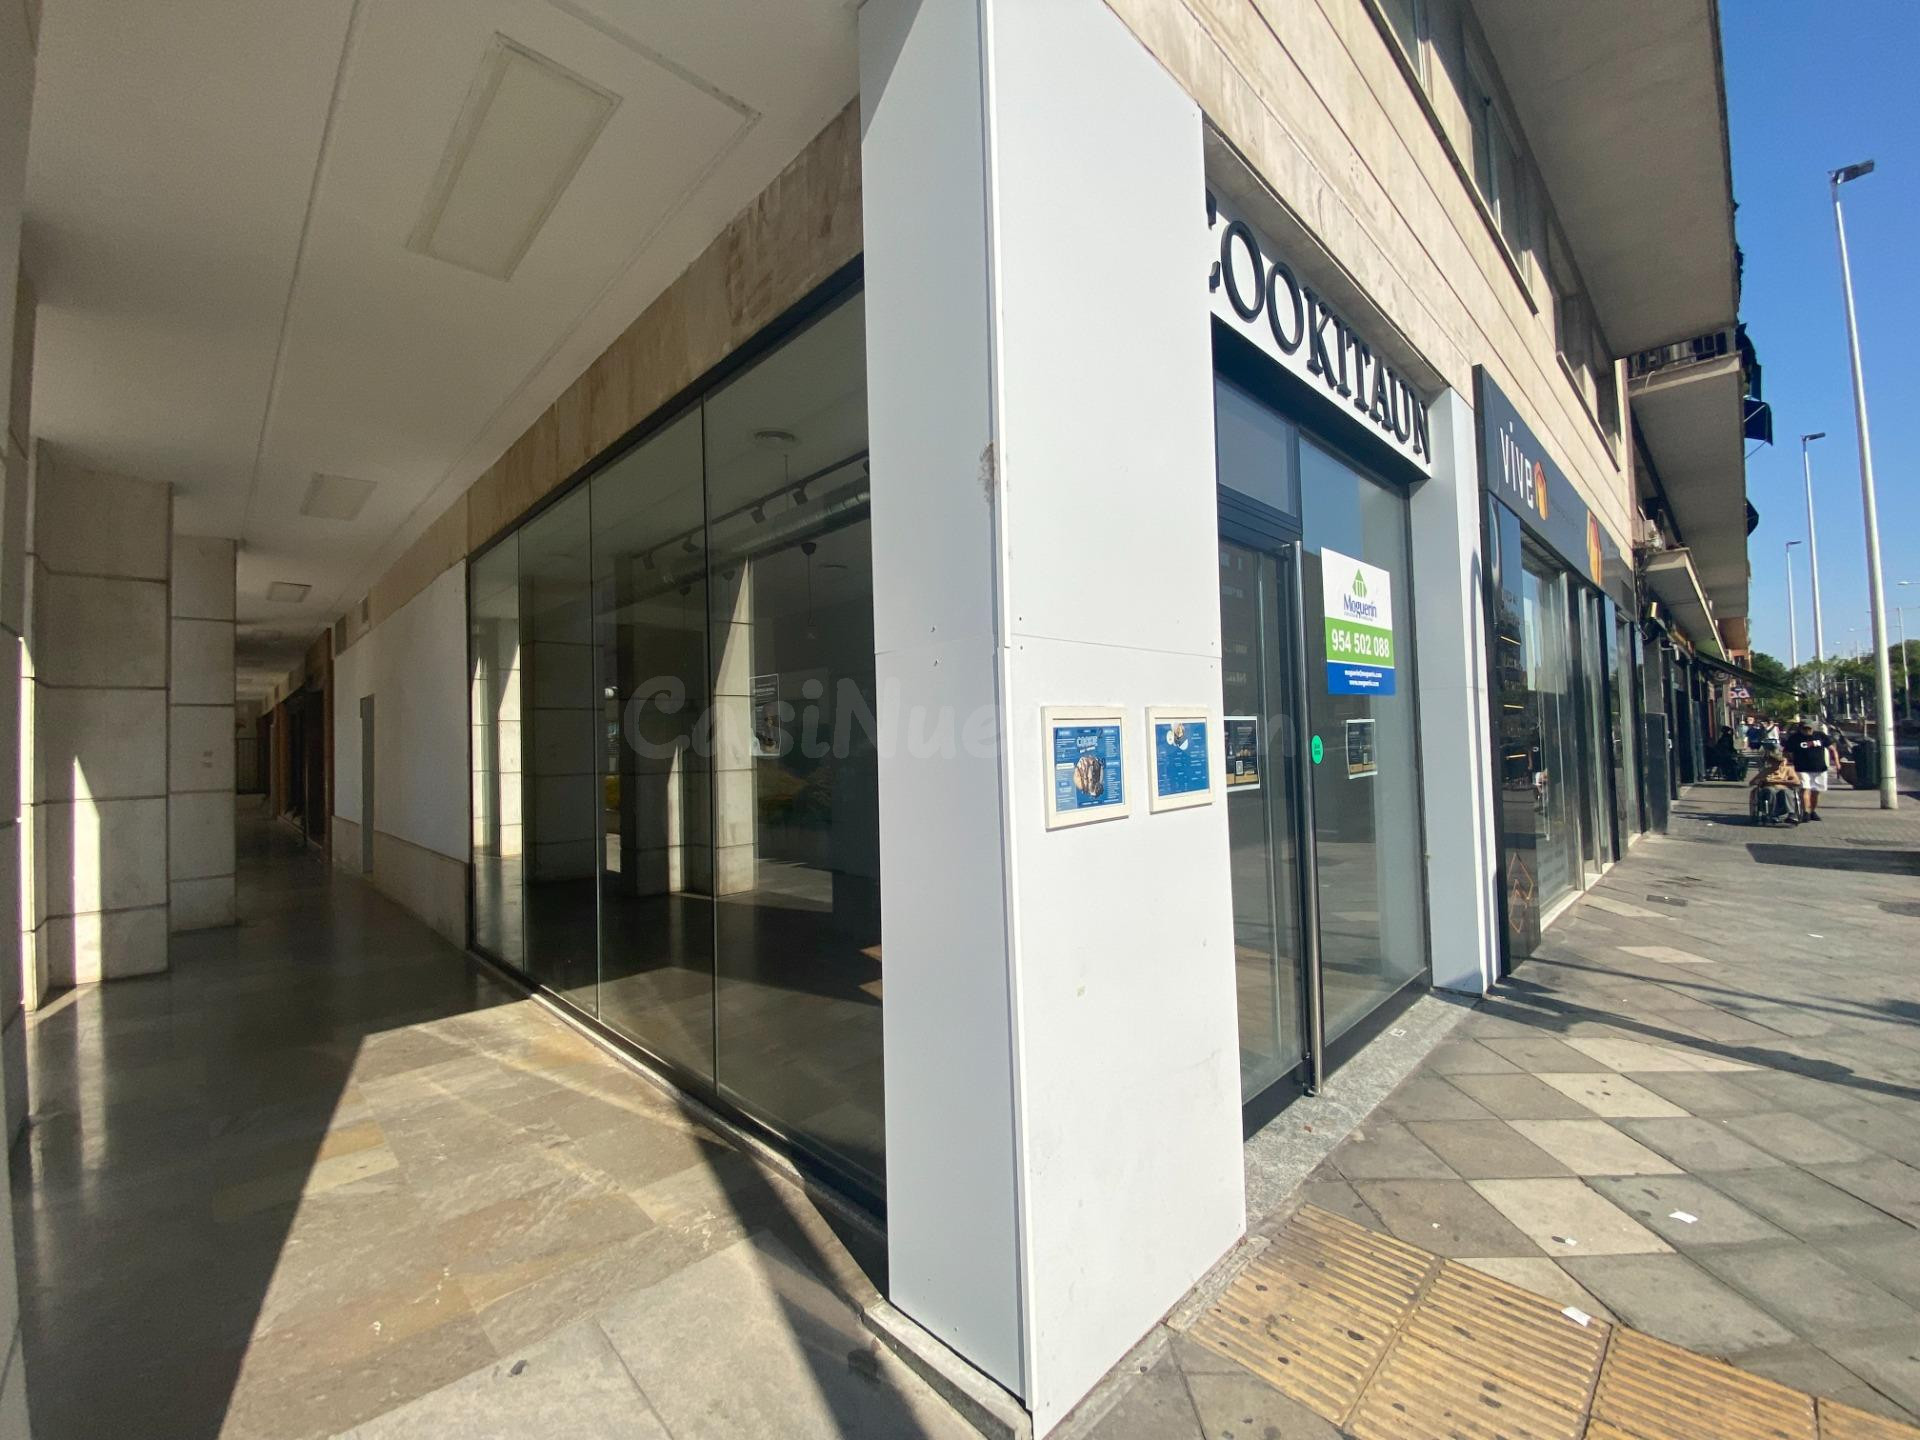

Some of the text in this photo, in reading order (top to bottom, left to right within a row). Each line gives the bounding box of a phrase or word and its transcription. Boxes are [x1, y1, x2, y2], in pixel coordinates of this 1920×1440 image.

[1206, 188, 1431, 464] OOKITAUN
[1499, 421, 1535, 510] vive
[1331, 628, 1390, 658] 954 502 088
